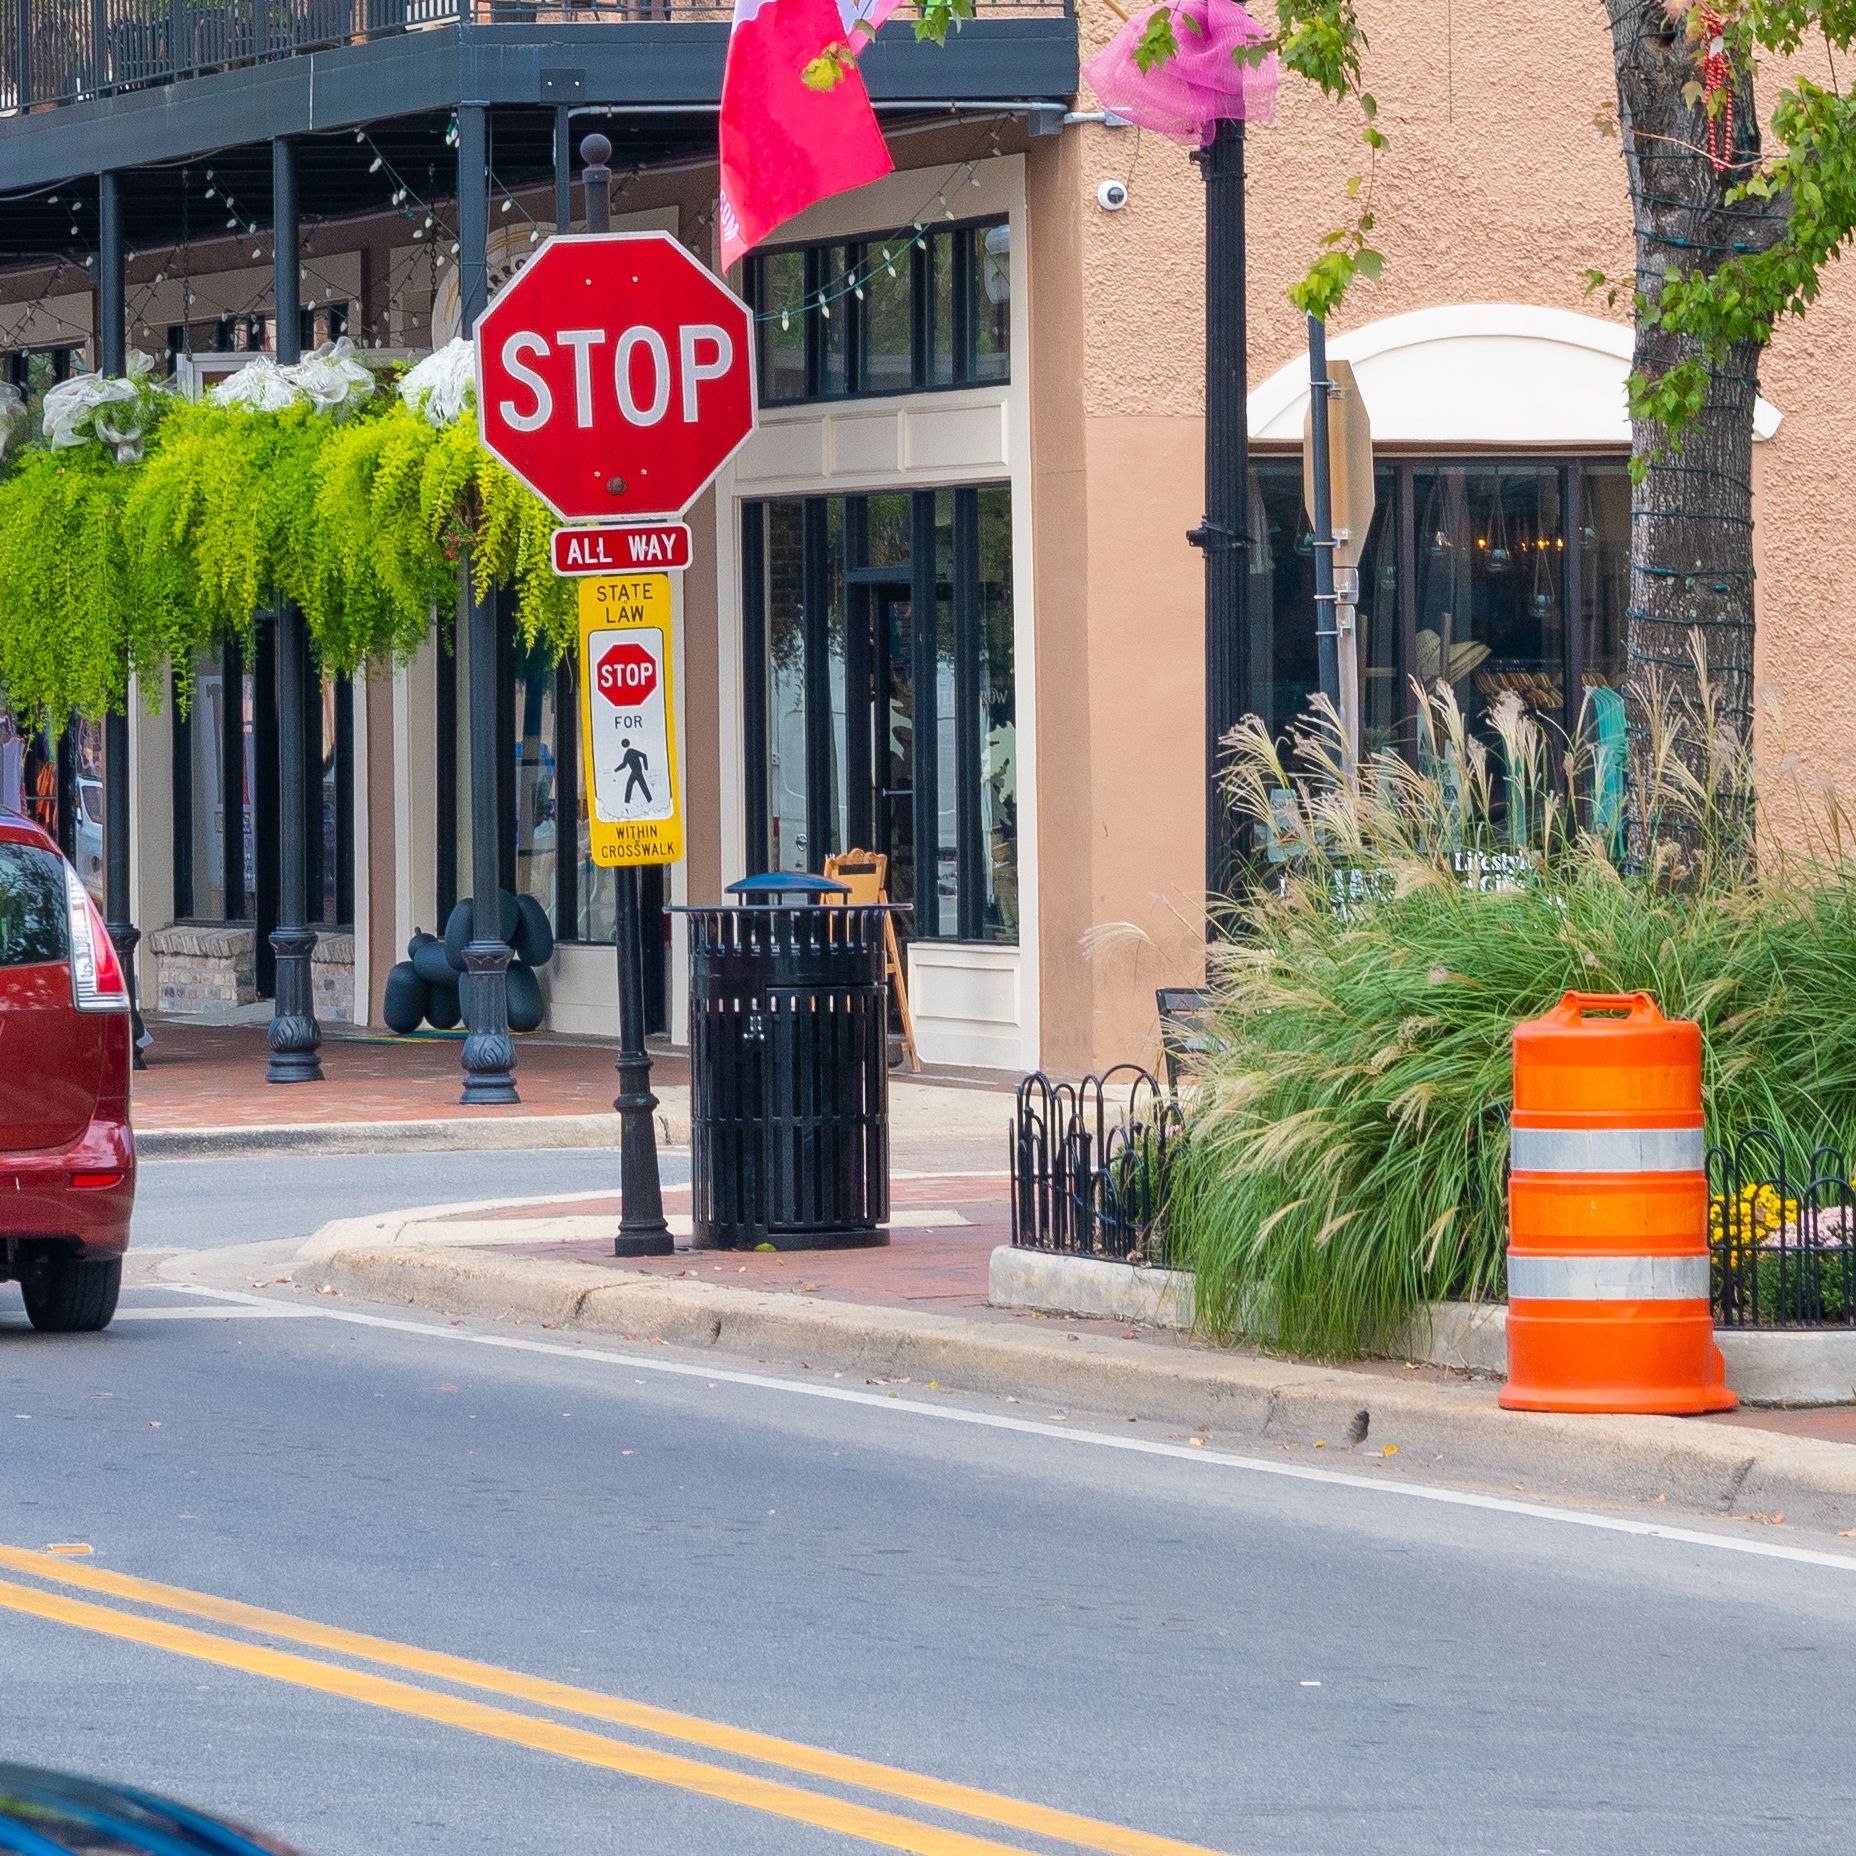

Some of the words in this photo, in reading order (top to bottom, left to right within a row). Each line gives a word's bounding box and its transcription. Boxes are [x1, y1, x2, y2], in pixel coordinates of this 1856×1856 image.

[499, 323, 734, 433] STOP
[566, 538, 613, 566] ALL
[628, 533, 677, 562] WAY
[596, 582, 654, 602] STATE
[605, 605, 645, 624] LAW
[600, 663, 654, 688] STOP
[614, 715, 644, 729] FOR
[616, 825, 659, 840] WITHIN
[601, 842, 675, 859] CROSSWALK
